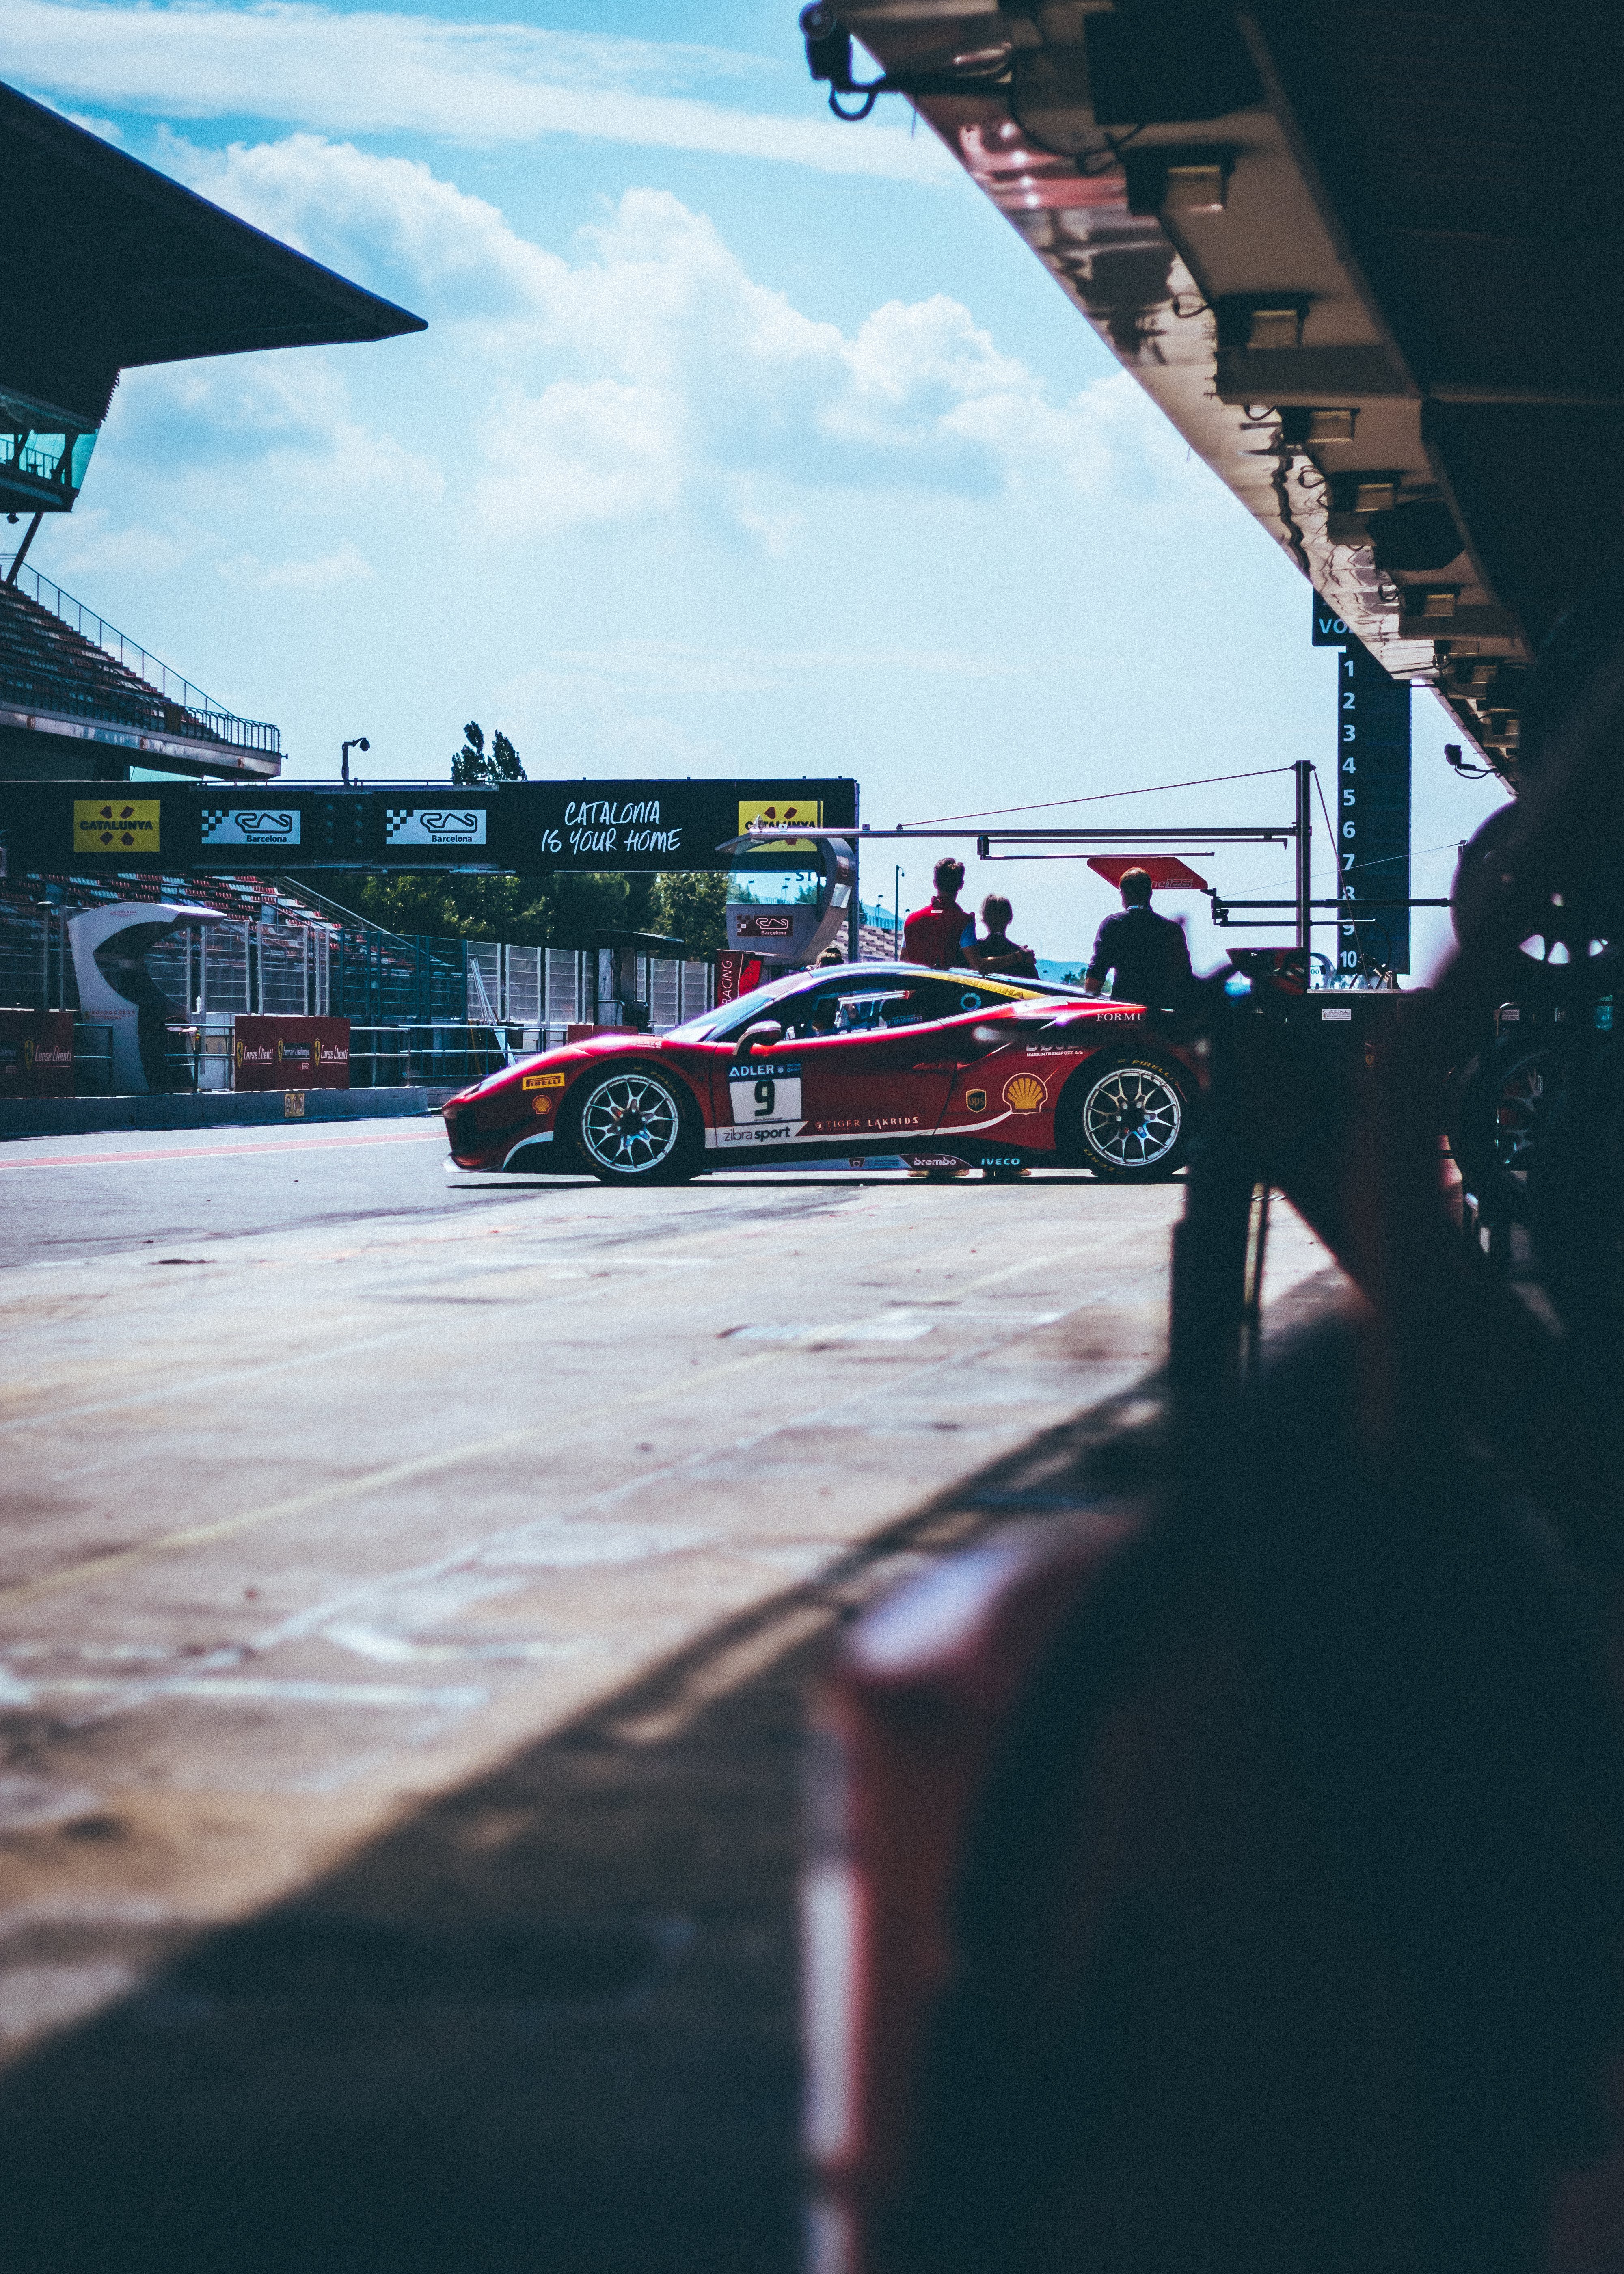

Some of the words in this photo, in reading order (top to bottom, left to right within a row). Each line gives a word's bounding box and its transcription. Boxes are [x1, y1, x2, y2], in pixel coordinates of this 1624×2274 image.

[1344, 660, 1354, 677] 1
[1343, 692, 1355, 709] 2
[1343, 725, 1356, 742] 3
[1342, 757, 1356, 773] 4
[1343, 789, 1356, 806] 5
[565, 800, 659, 825] CATALONIA
[80, 820, 153, 830] CATALUNYA
[1343, 821, 1356, 838] 6
[542, 829, 562, 852] IS
[570, 828, 618, 855] YOUR
[624, 828, 682, 852] HOME
[1343, 854, 1355, 871] 7
[1342, 886, 1356, 900] 8
[1340, 951, 1357, 968] 10
[722, 960, 732, 1005] RACING
[244, 1046, 257, 1060] Corse
[258, 1046, 273, 1060] Clienti
[321, 1045, 334, 1059] Corse
[334, 1045, 348, 1059] Clienti
[729, 1064, 774, 1076] ADLER
[526, 1075, 561, 1087] PIRELLI
[754, 1080, 775, 1117] 9
[827, 1119, 860, 1128] TIGER
[868, 1117, 918, 1129] LAKRIDS
[724, 1128, 753, 1141] zibra
[754, 1126, 791, 1143] sport
[914, 1158, 957, 1166] brembo
